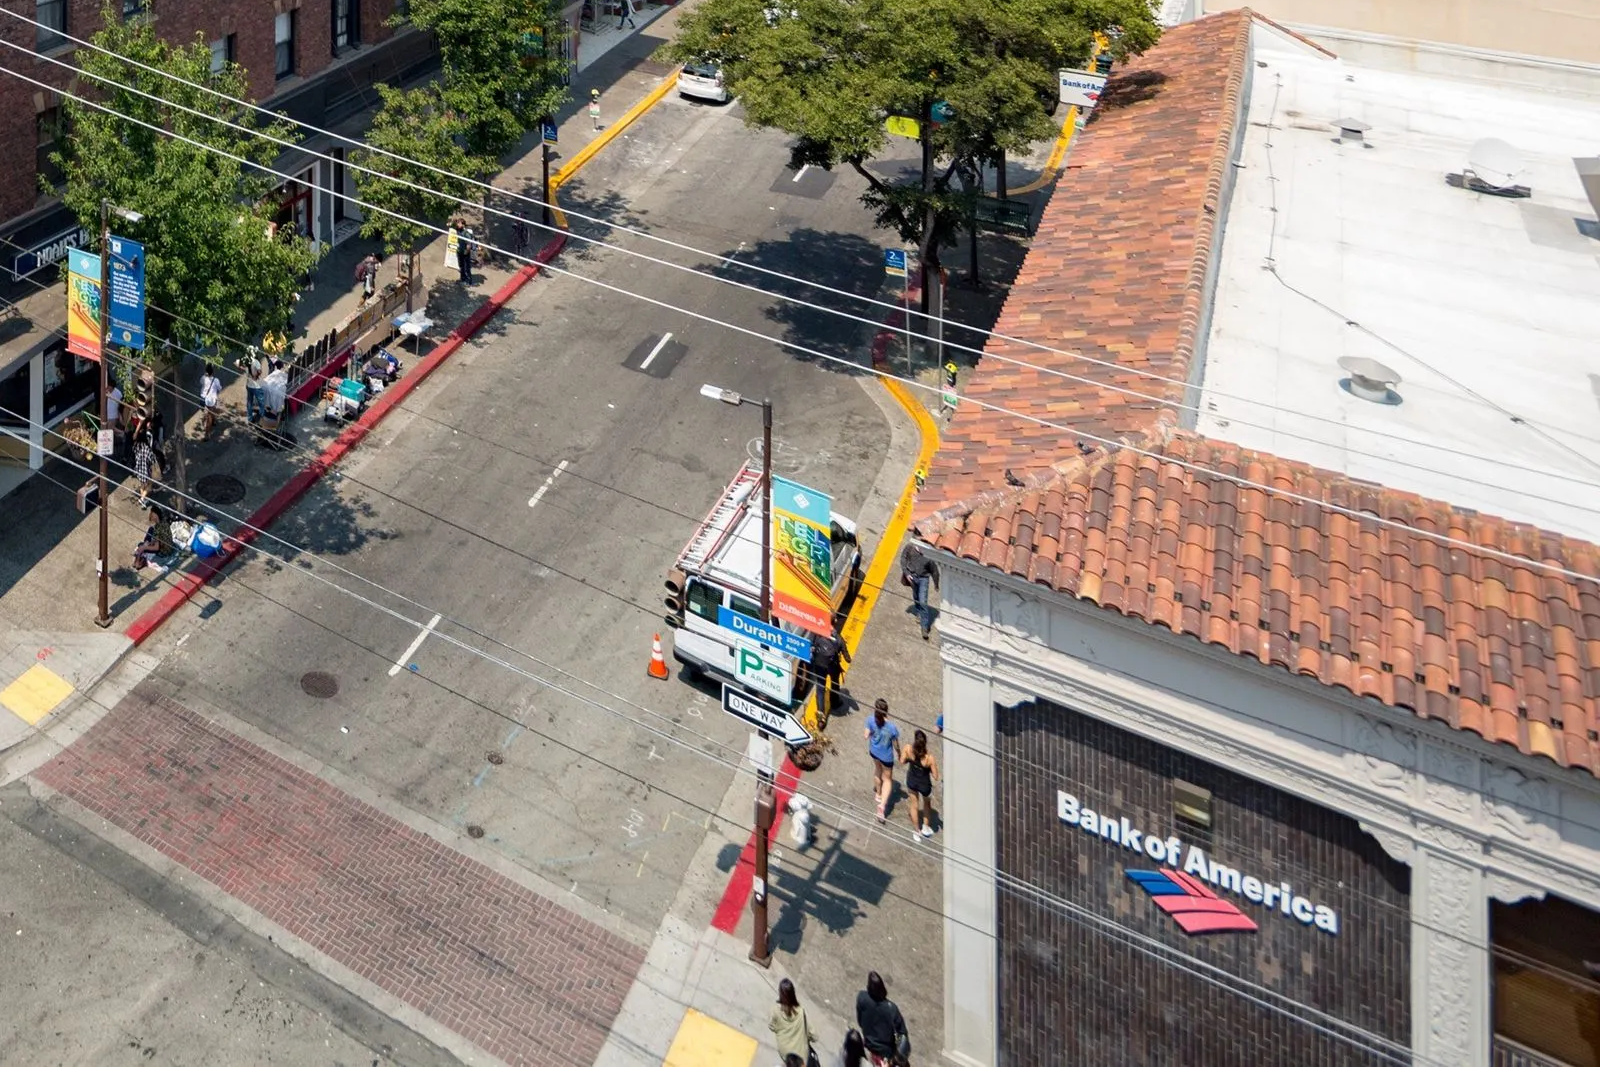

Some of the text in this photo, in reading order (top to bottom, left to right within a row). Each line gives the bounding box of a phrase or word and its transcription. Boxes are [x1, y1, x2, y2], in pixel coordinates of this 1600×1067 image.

[1062, 78, 1082, 88] Bank
[37, 234, 78, 268] NOAH'S
[732, 615, 783, 646] Durant
[732, 697, 757, 717] ONE
[760, 711, 785, 729] WAY
[1057, 789, 1339, 937] Bank of America
